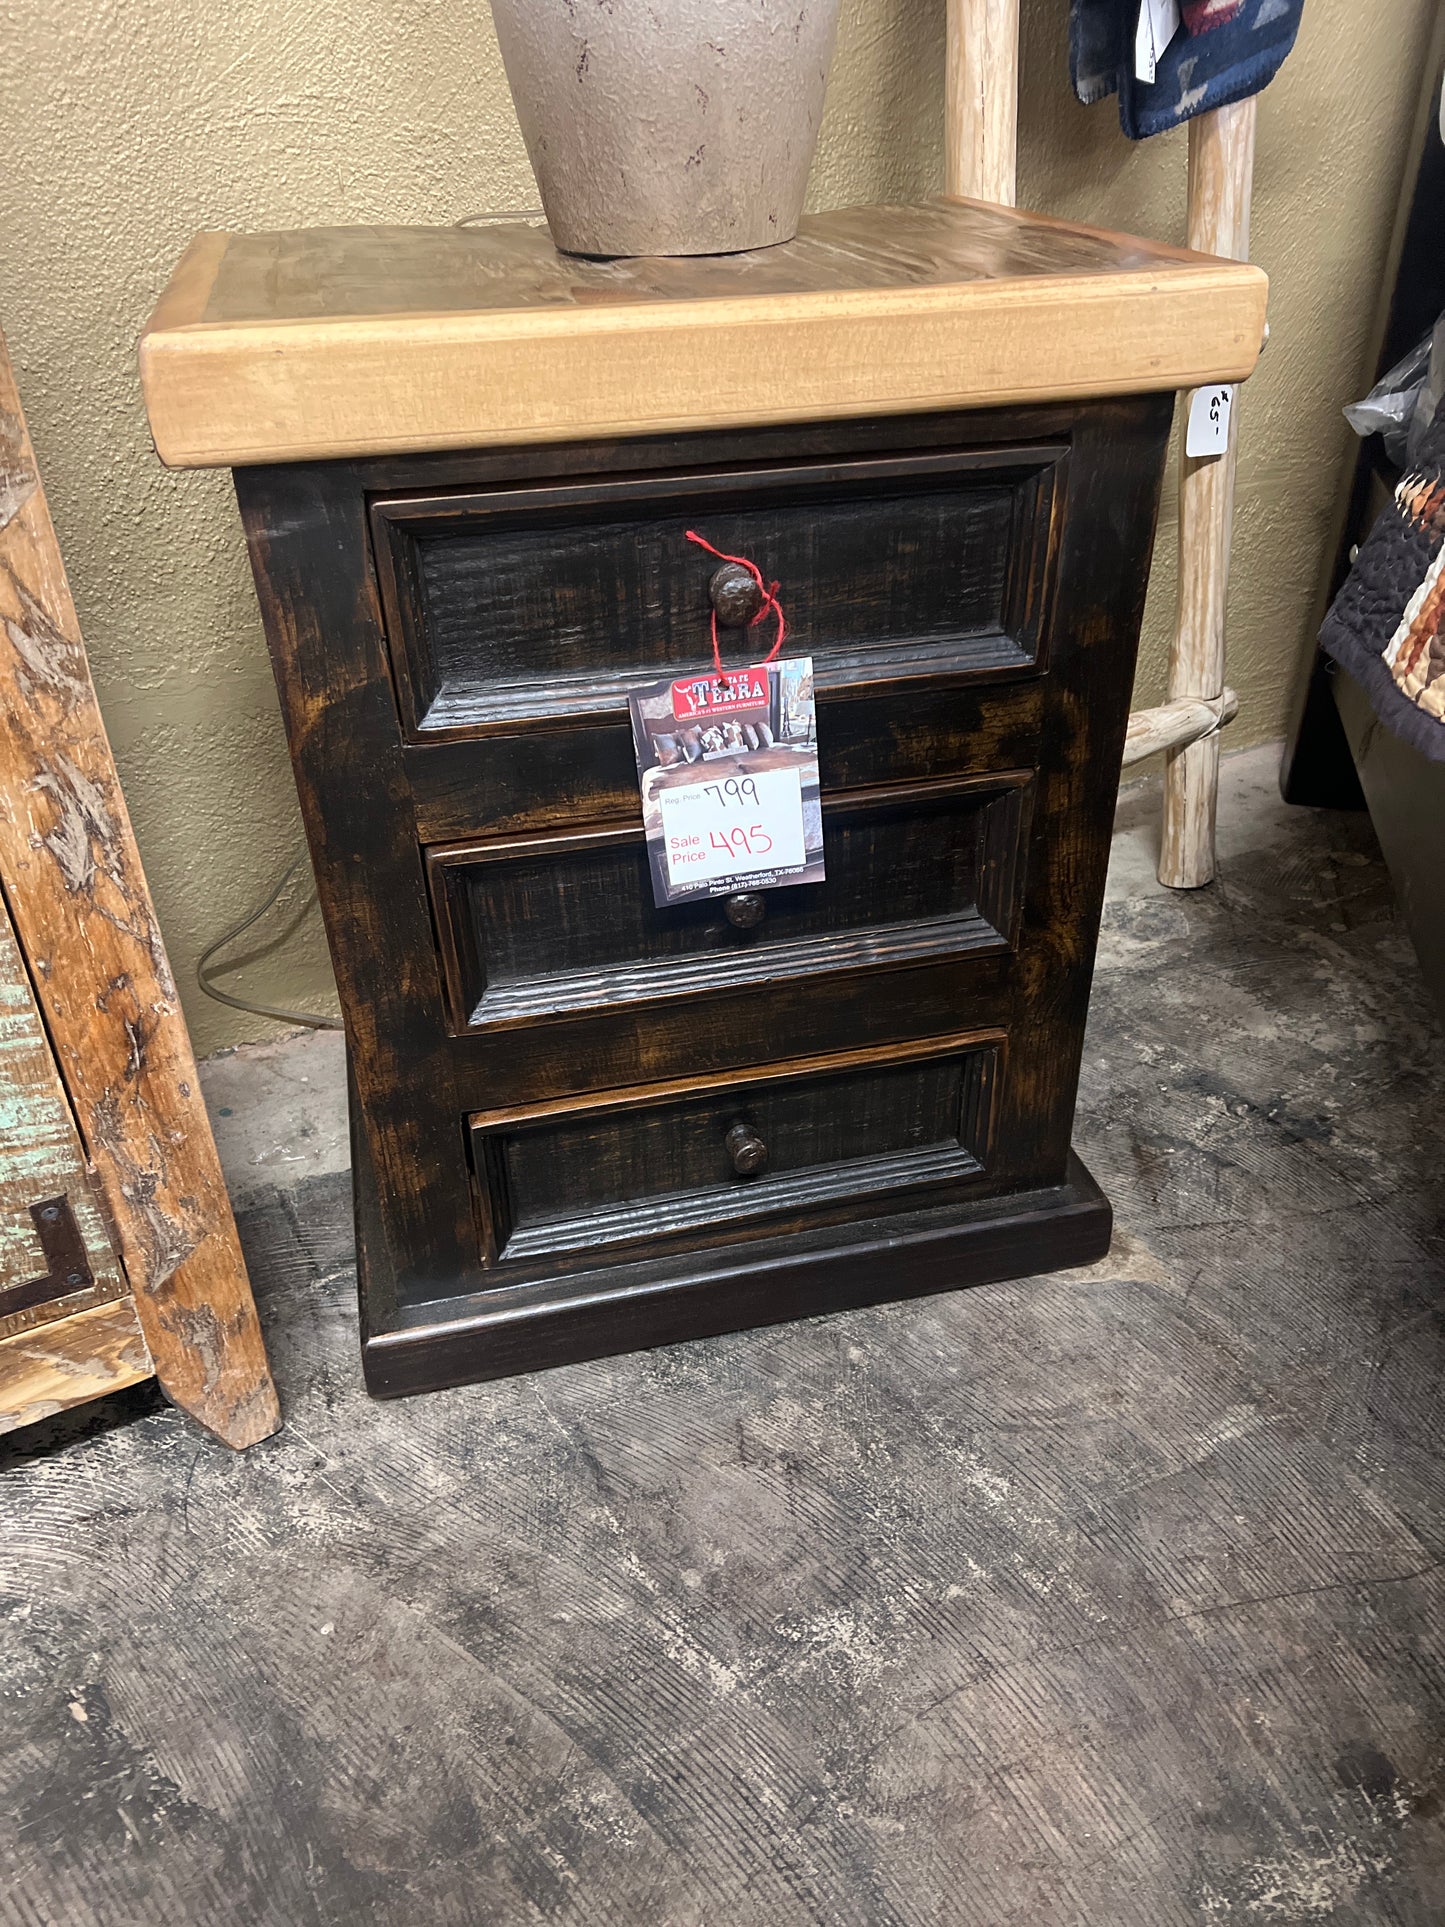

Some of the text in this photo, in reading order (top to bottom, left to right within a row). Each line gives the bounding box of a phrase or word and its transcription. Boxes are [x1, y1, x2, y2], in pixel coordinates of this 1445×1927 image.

[712, 676, 737, 686] STA
[691, 680, 764, 706] TERRA
[712, 704, 736, 713] WESTERN
[736, 700, 765, 708] FURNITURE
[683, 794, 701, 802] Price
[703, 778, 760, 807] 799
[670, 824, 773, 858] Sale 495
[672, 851, 706, 865] Price
[709, 878, 725, 887] Pinto
[735, 872, 774, 882] Weatherford,
[710, 884, 731, 893] Phone
